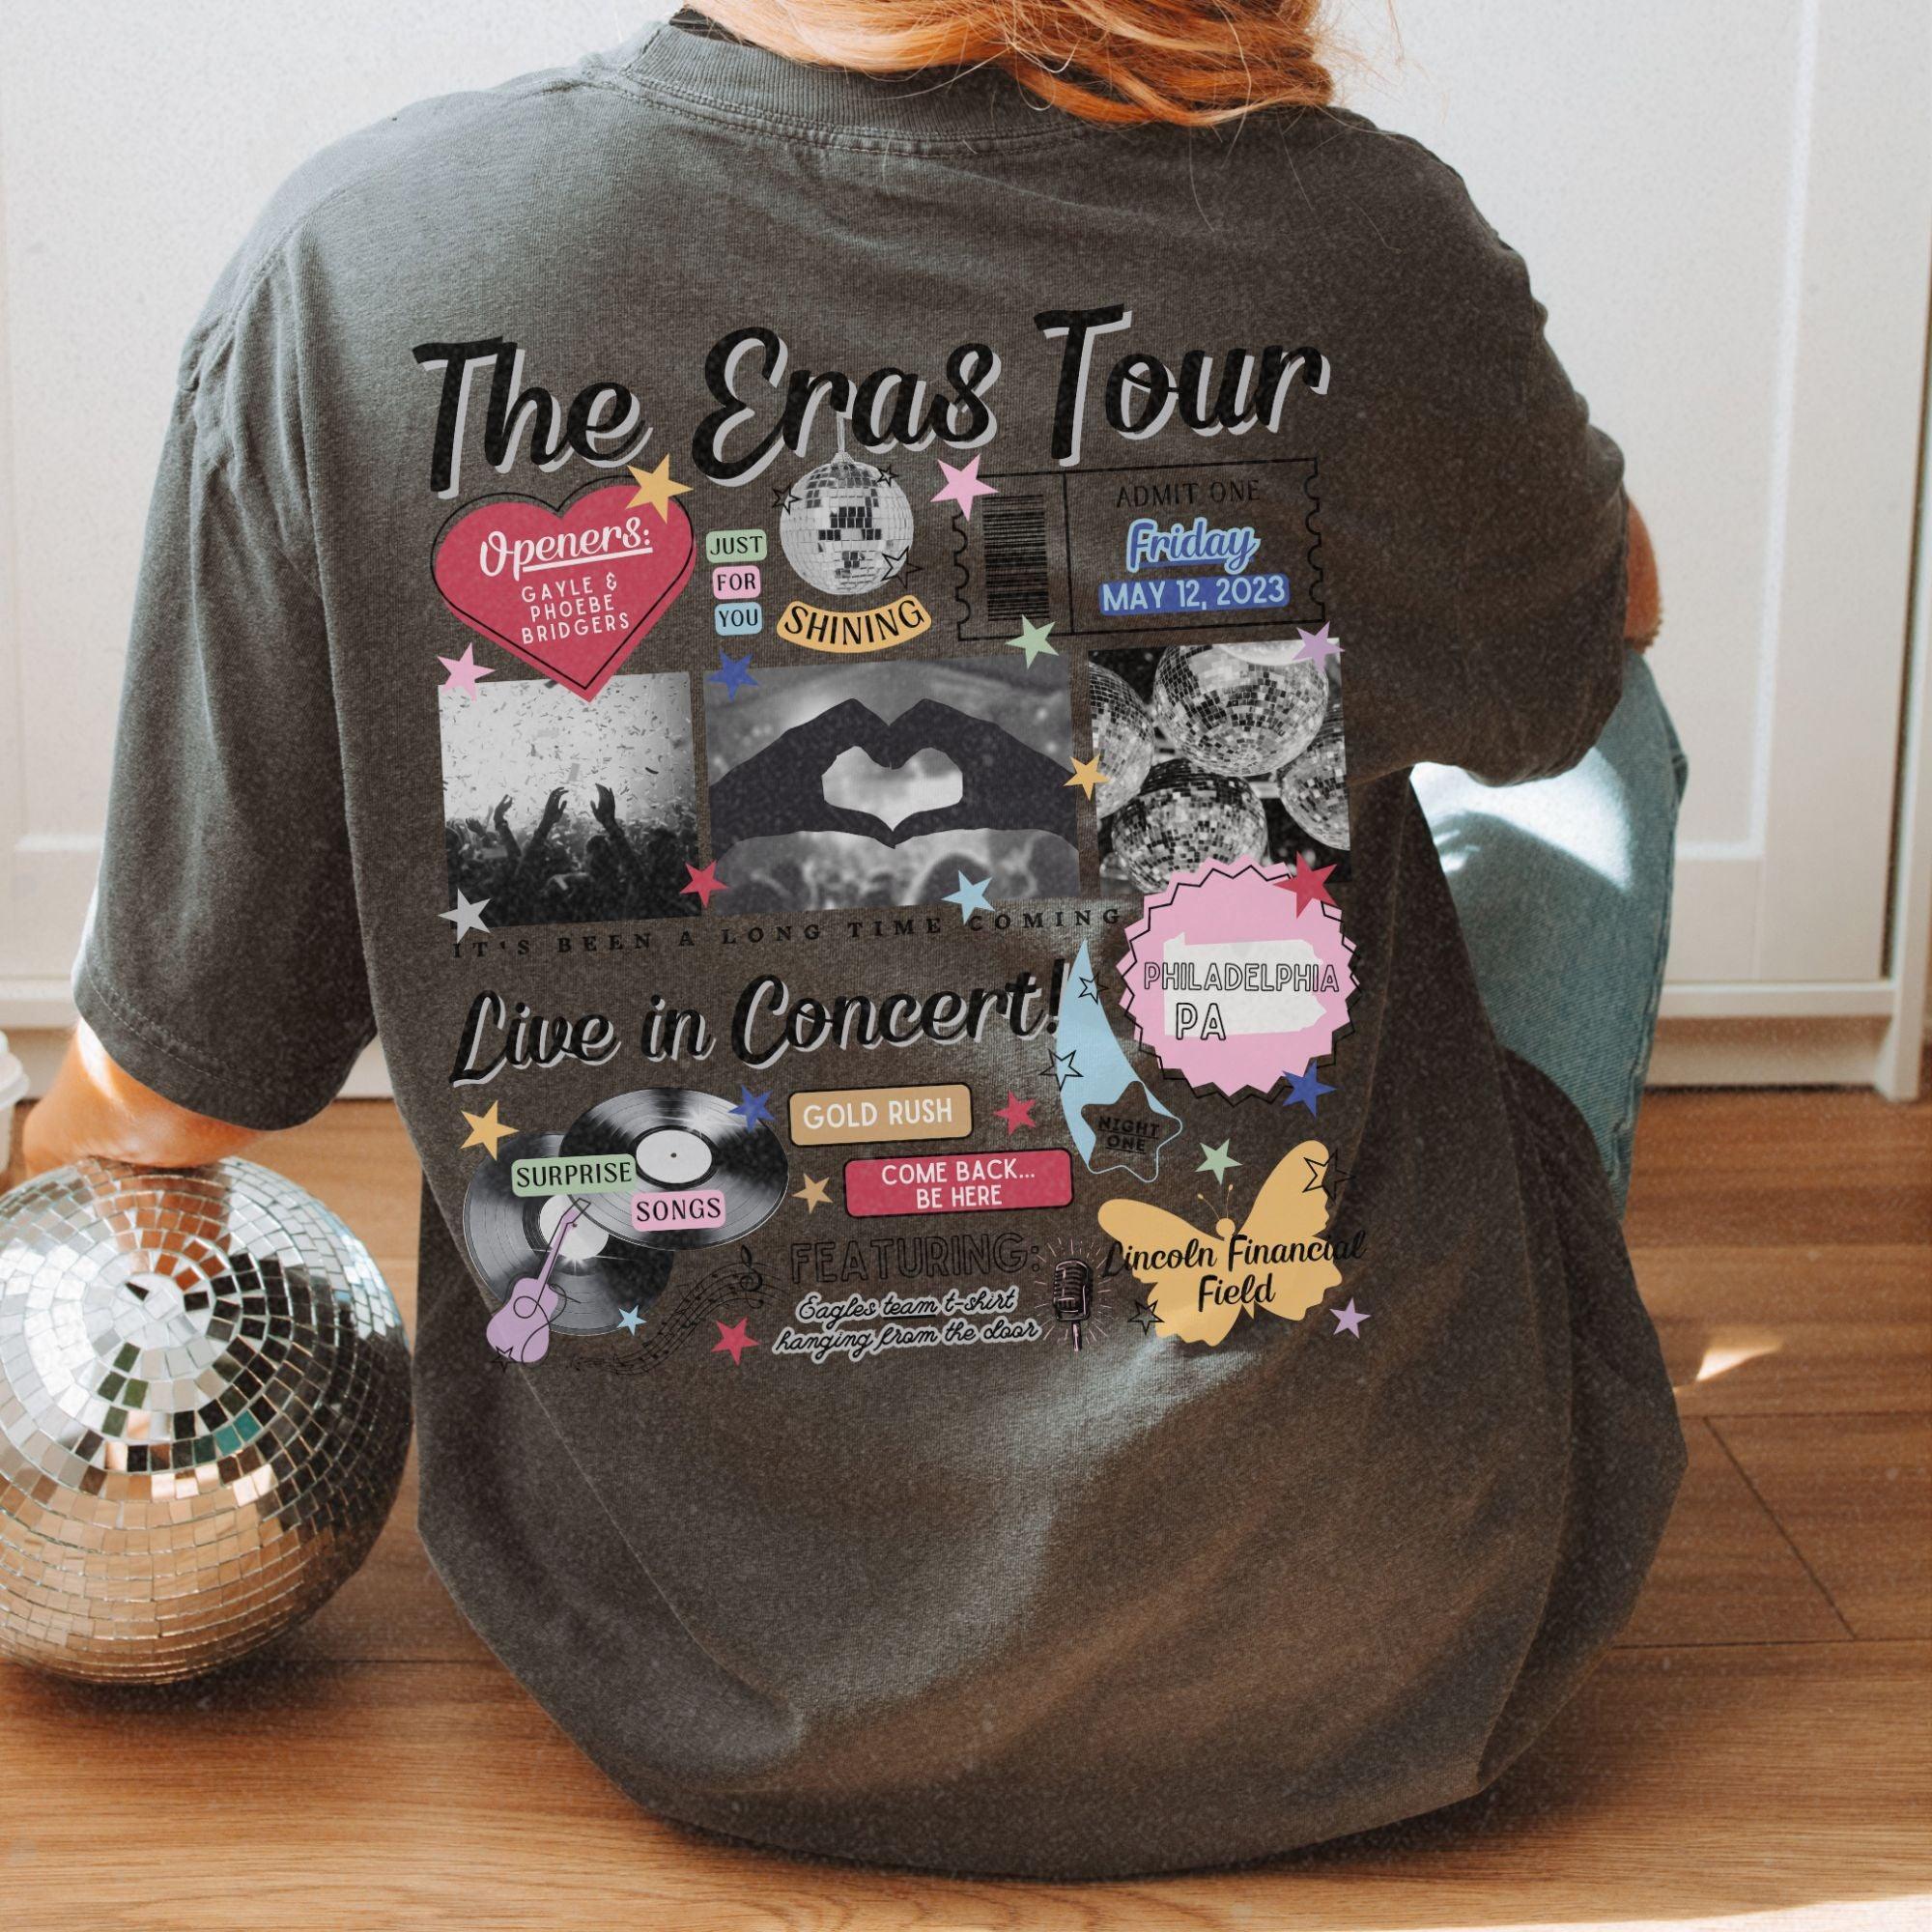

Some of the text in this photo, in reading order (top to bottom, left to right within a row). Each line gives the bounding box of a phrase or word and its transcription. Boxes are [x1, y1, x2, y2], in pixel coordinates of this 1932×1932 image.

[412, 303, 1330, 498] The Eras Tour
[1117, 480, 1260, 508] ADMIT ONE
[480, 517, 653, 581] Openers:
[710, 535, 763, 556] JUST
[1126, 517, 1261, 575] Friday
[522, 572, 617, 603] GAYLE &
[717, 572, 756, 592] FOR
[1103, 576, 1286, 611] MAY 12, 2023
[530, 595, 614, 622] PHOEBE
[718, 608, 758, 628] YOU
[783, 599, 925, 648] SHINING
[522, 613, 630, 644] BRIDGERS
[453, 908, 1121, 958] IT'S BEEN A LONG TIME COMING
[1144, 962, 1339, 992] PHILADELPHIA
[449, 958, 1069, 1088] Live in Concert!
[1176, 1002, 1227, 1040] PA
[804, 1097, 952, 1129] GOLD RUSH
[1098, 1115, 1160, 1138] NIGHT
[1106, 1128, 1147, 1152] ONE
[516, 1161, 633, 1188] SURPRISE
[882, 1158, 1036, 1185] COME BACK...
[636, 1197, 722, 1222] SONGS
[917, 1184, 1002, 1209] BE HERE
[790, 1233, 1040, 1284] FEATURING:
[1102, 1230, 1367, 1278] Lincoln Financial
[1198, 1273, 1276, 1312] Field
[798, 1290, 1016, 1329] Eagles team t-shirt
[775, 1320, 1040, 1361] hanging from the door
